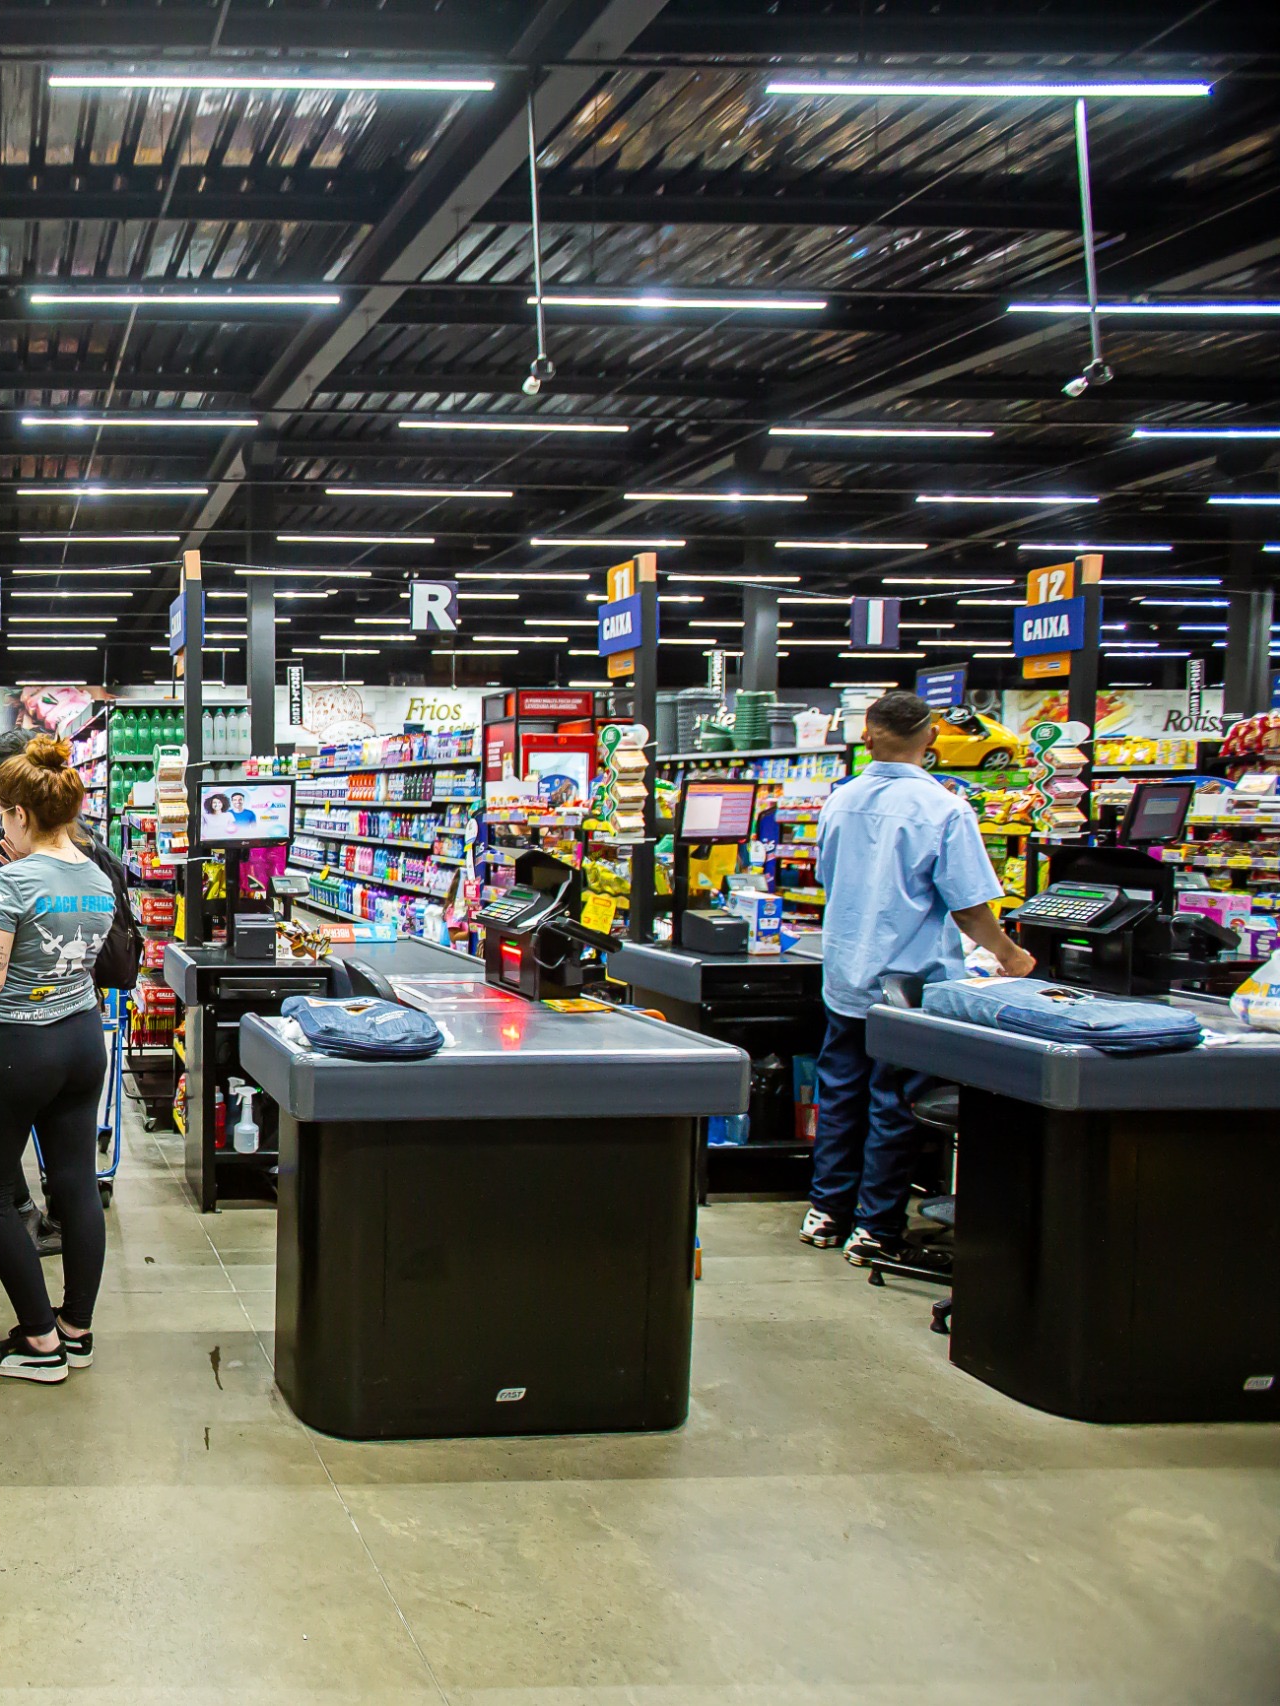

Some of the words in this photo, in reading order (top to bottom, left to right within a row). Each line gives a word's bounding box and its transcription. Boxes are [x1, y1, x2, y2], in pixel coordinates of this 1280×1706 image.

[614, 567, 631, 602] 11
[1036, 569, 1066, 604] 12
[411, 583, 457, 631] R
[602, 611, 633, 641] CAIXA
[1022, 614, 1070, 642] CAIXA
[405, 697, 462, 721] Frios
[35, 895, 78, 915] BLACK
